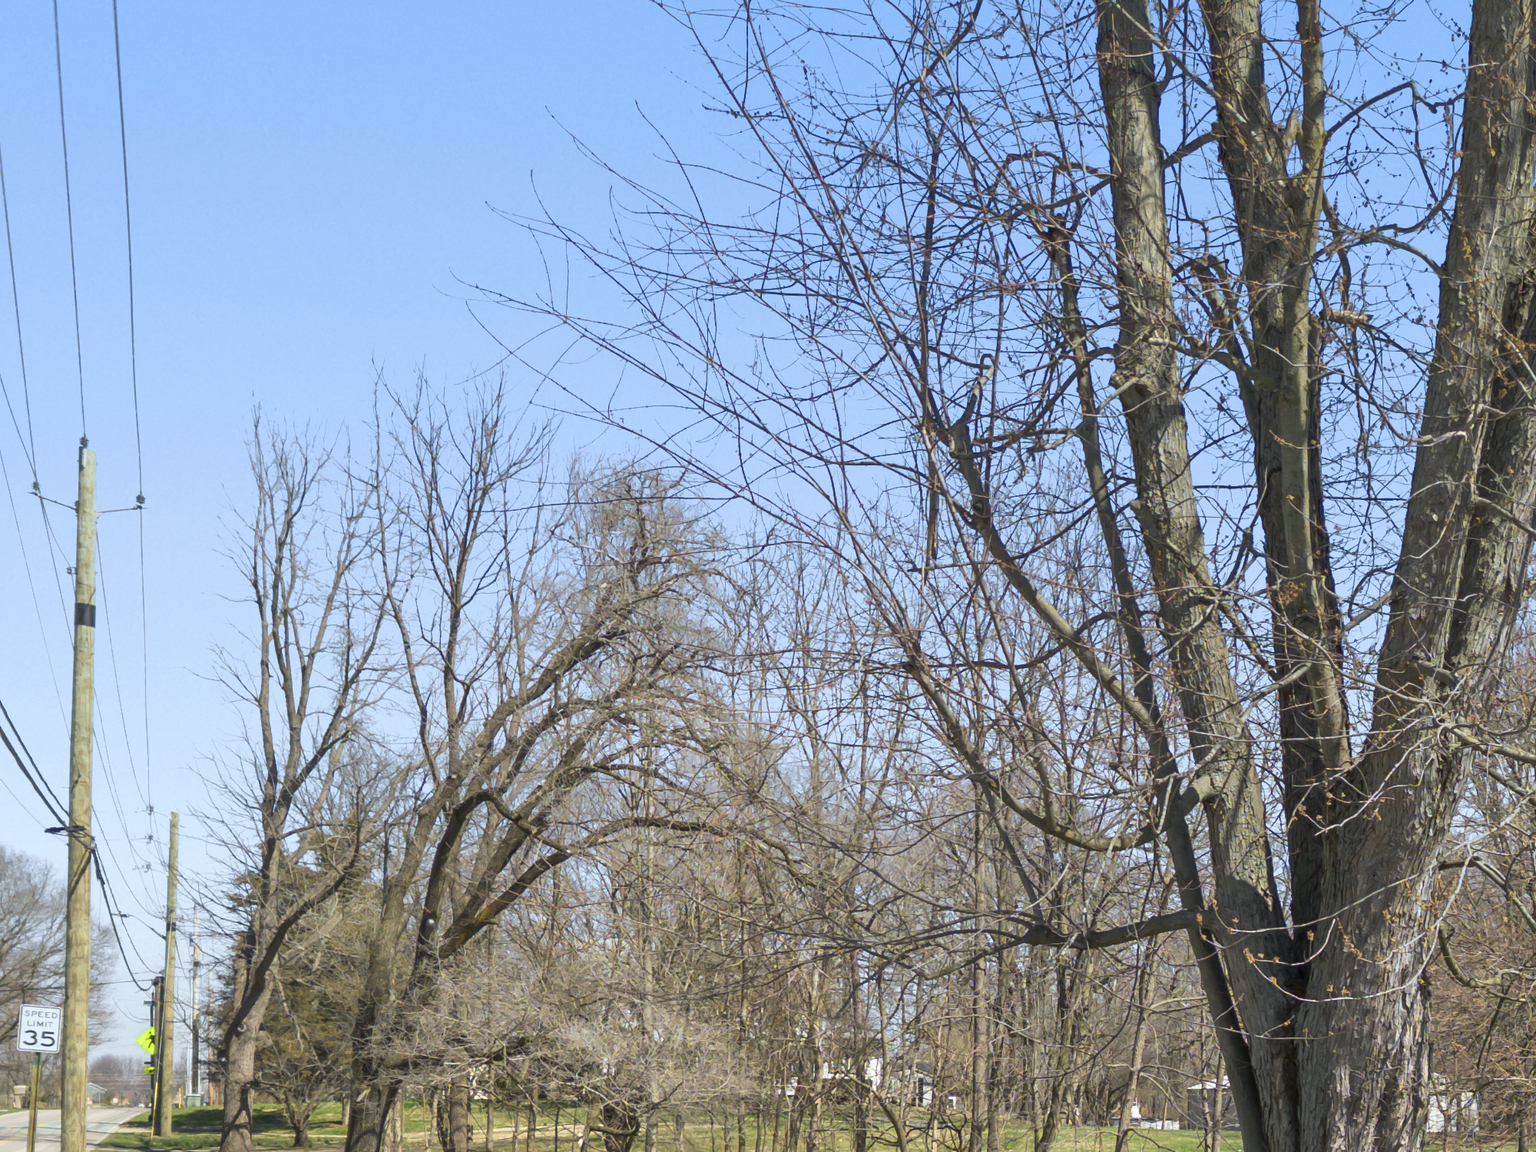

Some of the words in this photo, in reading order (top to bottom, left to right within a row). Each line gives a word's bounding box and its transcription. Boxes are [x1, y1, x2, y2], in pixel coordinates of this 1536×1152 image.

[24, 1010, 58, 1019] SPEED
[27, 1020, 53, 1028] LIMIT
[23, 1030, 55, 1047] 35
